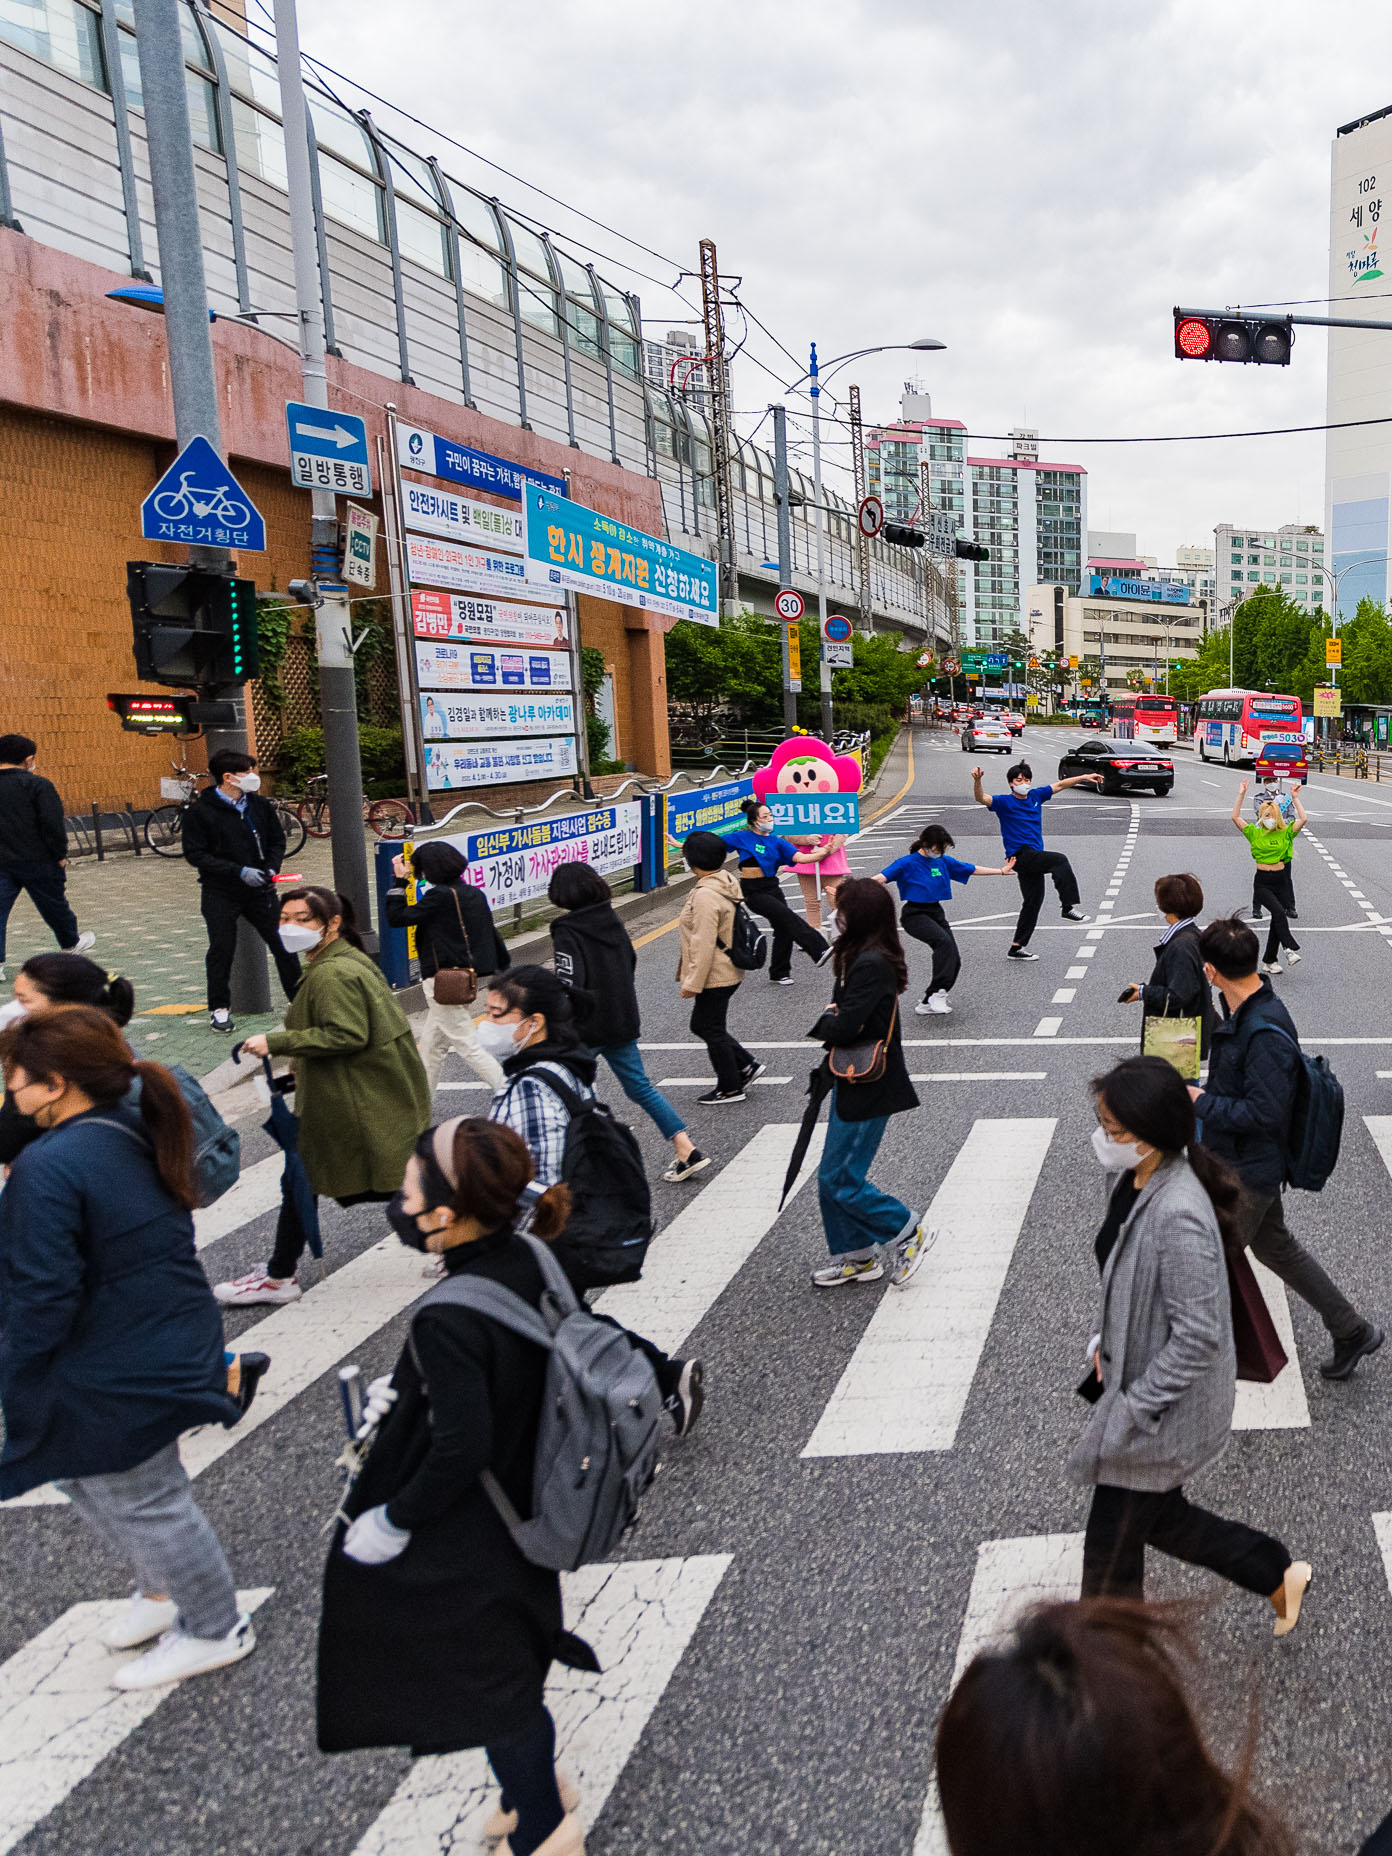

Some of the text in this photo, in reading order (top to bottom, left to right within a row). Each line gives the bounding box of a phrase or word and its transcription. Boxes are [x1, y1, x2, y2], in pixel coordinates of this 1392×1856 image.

[1358, 176, 1376, 194] 102
[298, 457, 364, 491] 일방통행
[446, 450, 471, 474] 구민이
[472, 458, 495, 481] 꿈꾸는
[409, 490, 459, 523] 안전카시트
[462, 504, 470, 525] 및
[158, 522, 249, 545] 자전거횡단
[594, 518, 616, 537] 소득이
[355, 538, 369, 556] CCTV
[349, 561, 371, 582] 단속중
[493, 560, 503, 572] 위한
[505, 562, 525, 577] 프로그램
[548, 525, 583, 568] 한시
[590, 541, 649, 588] 생계지원
[654, 562, 710, 607] 신청하세요
[780, 600, 799, 613] 30
[415, 611, 448, 634] 김병민
[478, 707, 507, 722] 함께하는
[508, 705, 536, 723] 광나루
[538, 704, 572, 722] 아카데미
[772, 803, 855, 825] 힘내요!
[476, 810, 612, 857] 임신부 가사돌봄 지원사업 접수중
[490, 855, 526, 890] 가정에
[591, 826, 639, 862] 보내드립니다
